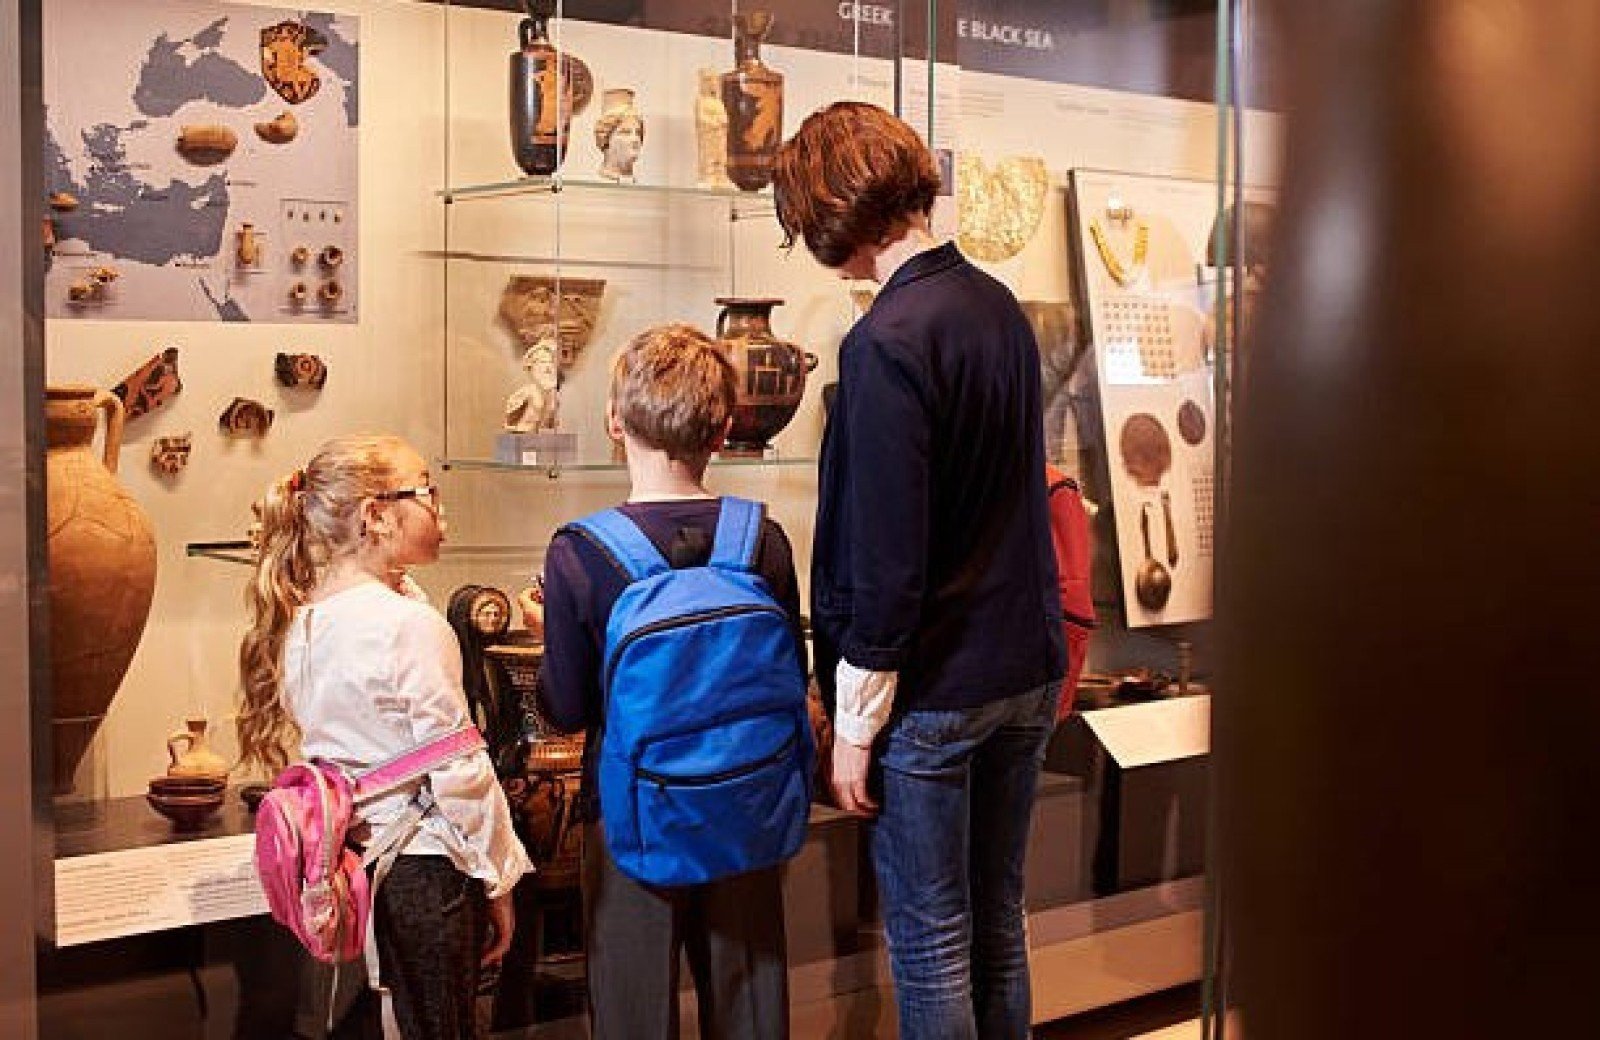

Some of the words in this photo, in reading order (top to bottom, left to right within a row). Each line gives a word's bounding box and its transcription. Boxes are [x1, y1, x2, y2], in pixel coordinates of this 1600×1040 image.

[838, 2, 894, 25] GREEK
[957, 19, 969, 38] E
[972, 20, 1022, 45] BLACK
[1024, 28, 1053, 49] SEA
